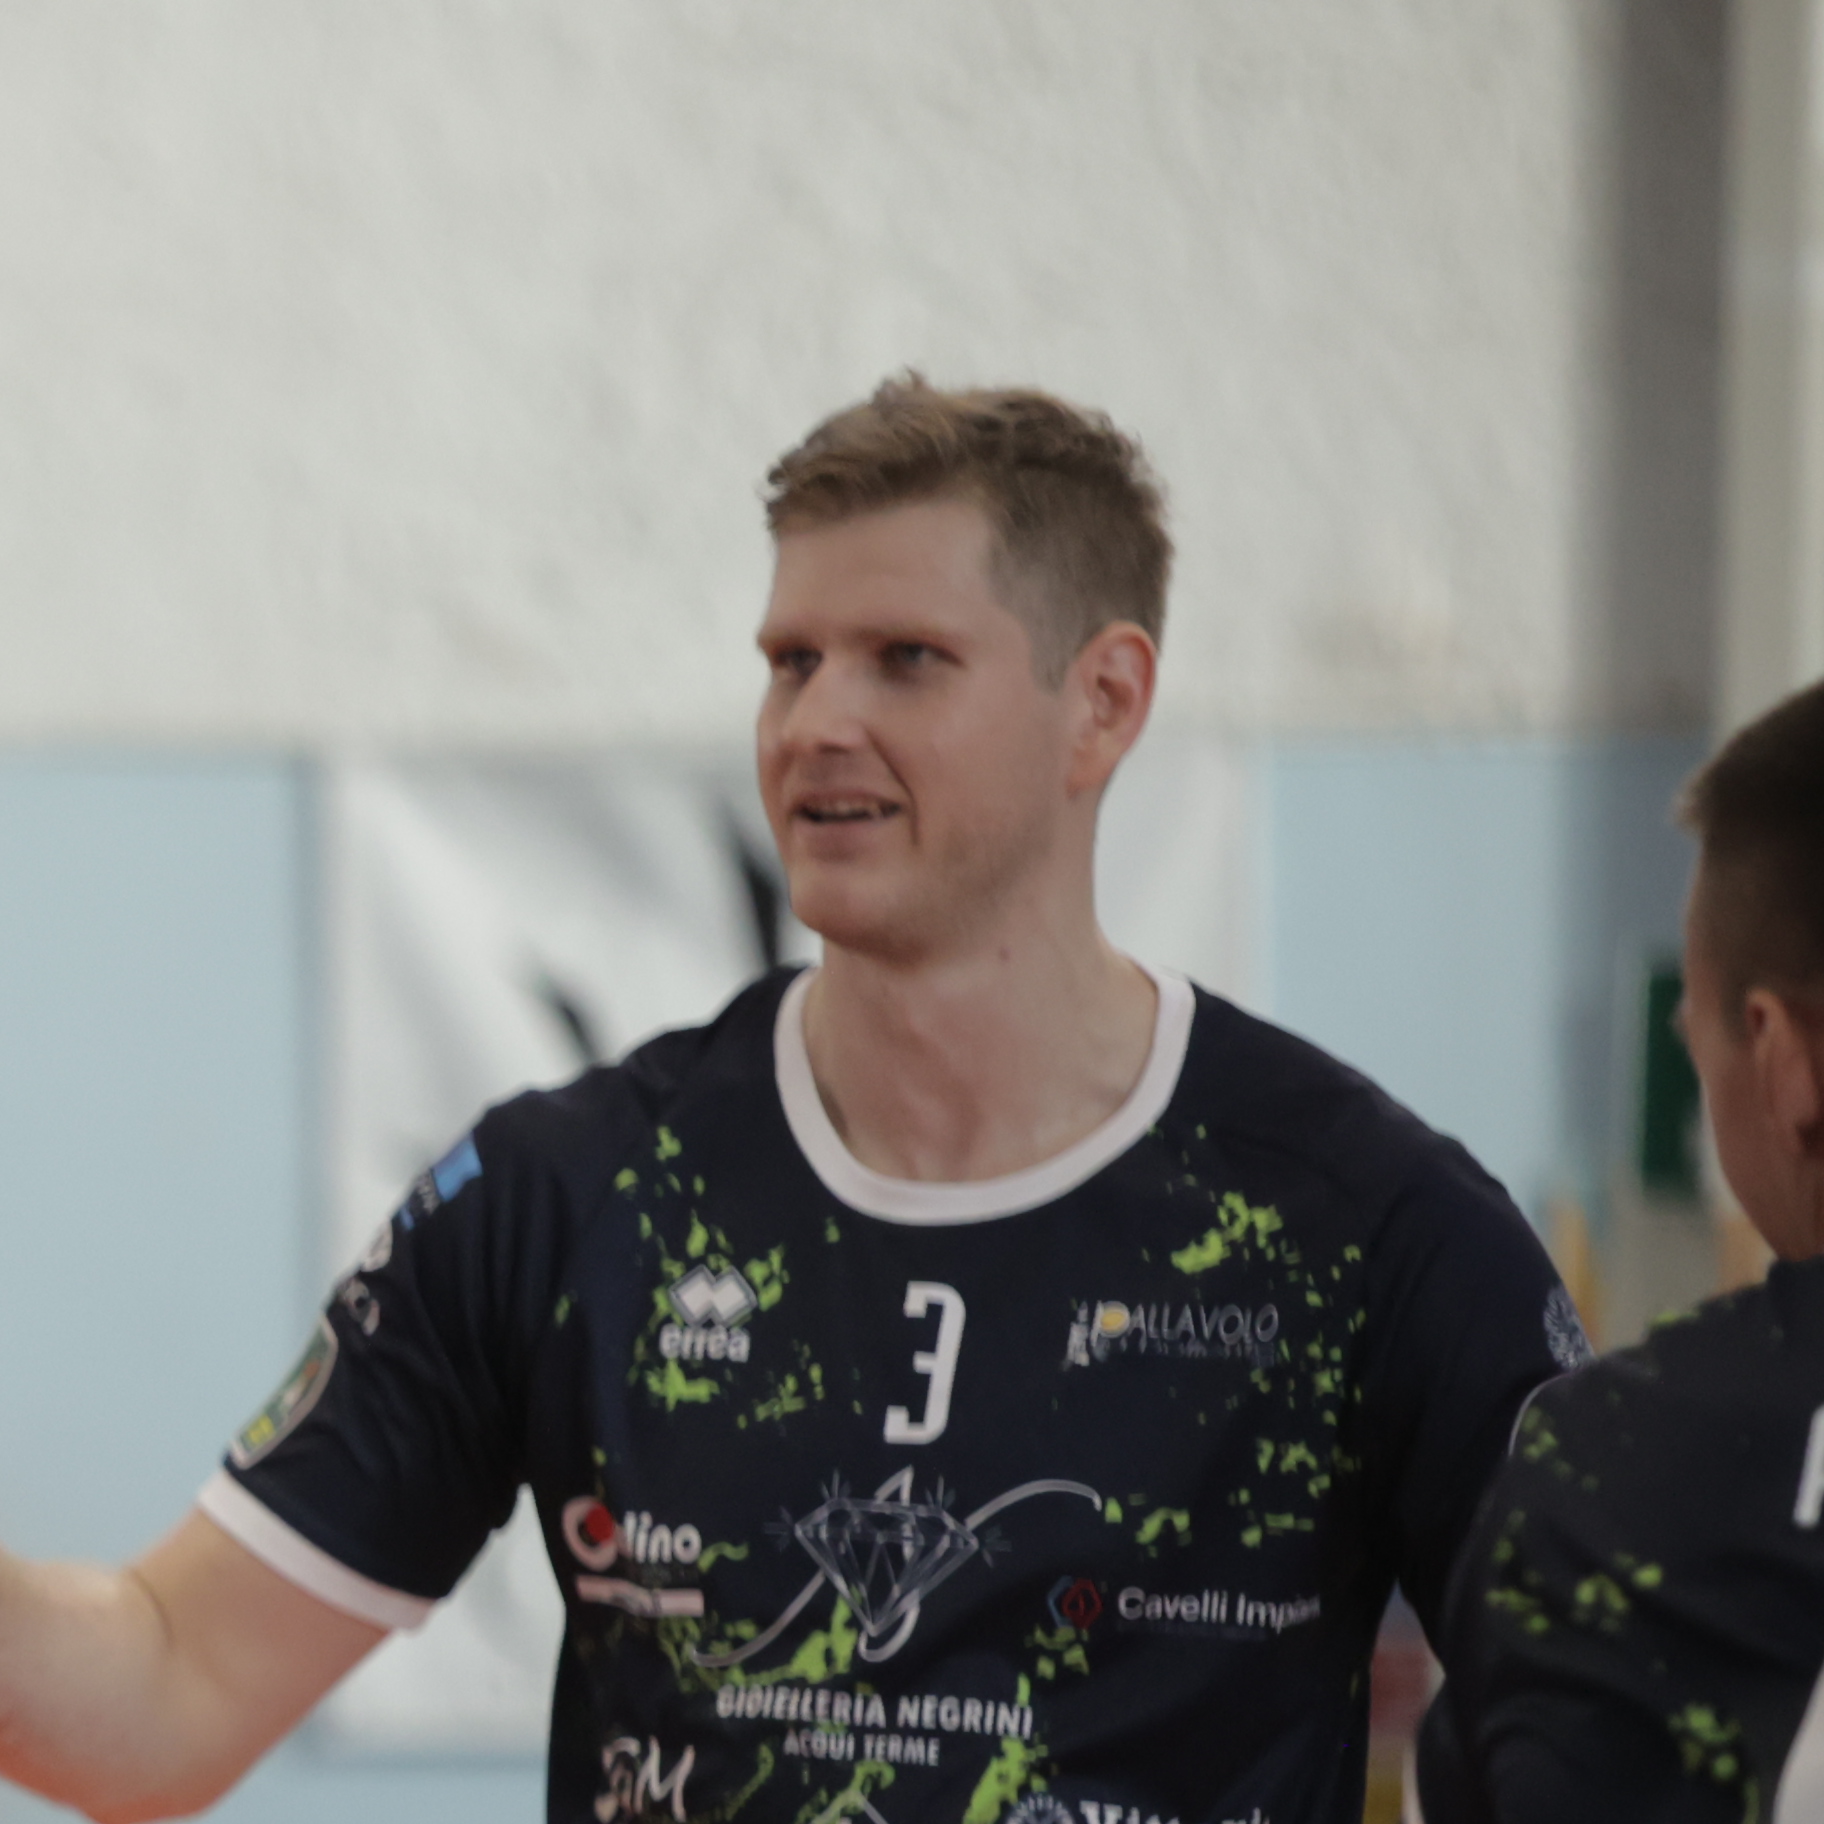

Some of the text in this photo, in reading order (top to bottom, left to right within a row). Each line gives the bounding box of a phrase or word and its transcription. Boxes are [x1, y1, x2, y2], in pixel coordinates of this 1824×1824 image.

[883, 1281, 965, 1445] 3
[897, 1694, 1033, 1740] NEGRINI
[783, 1728, 940, 1766] ACQUI TERME
